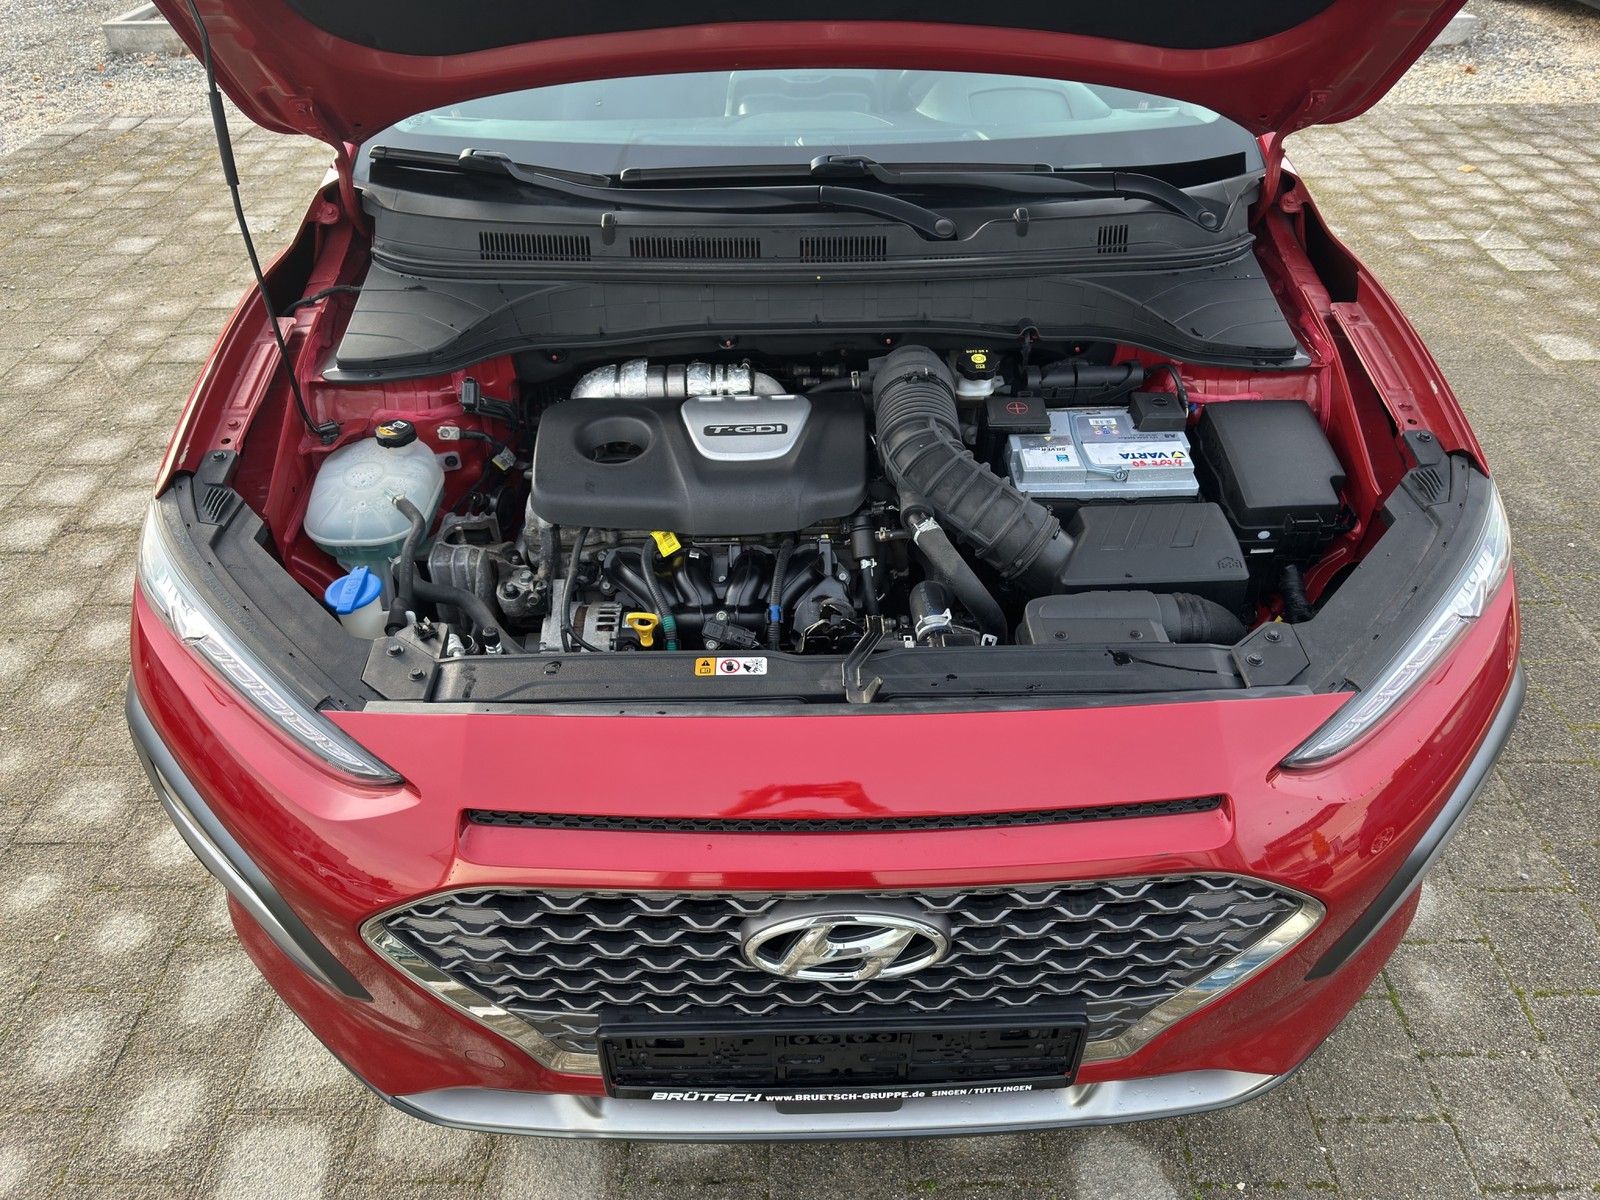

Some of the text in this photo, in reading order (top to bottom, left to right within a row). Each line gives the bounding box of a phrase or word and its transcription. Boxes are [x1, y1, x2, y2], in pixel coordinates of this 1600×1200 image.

[709, 424, 783, 434] T-GDI
[651, 1091, 763, 1102] BRÜTSCH
[765, 1091, 926, 1101] www.BRUETSCH-GRUPPE.de
